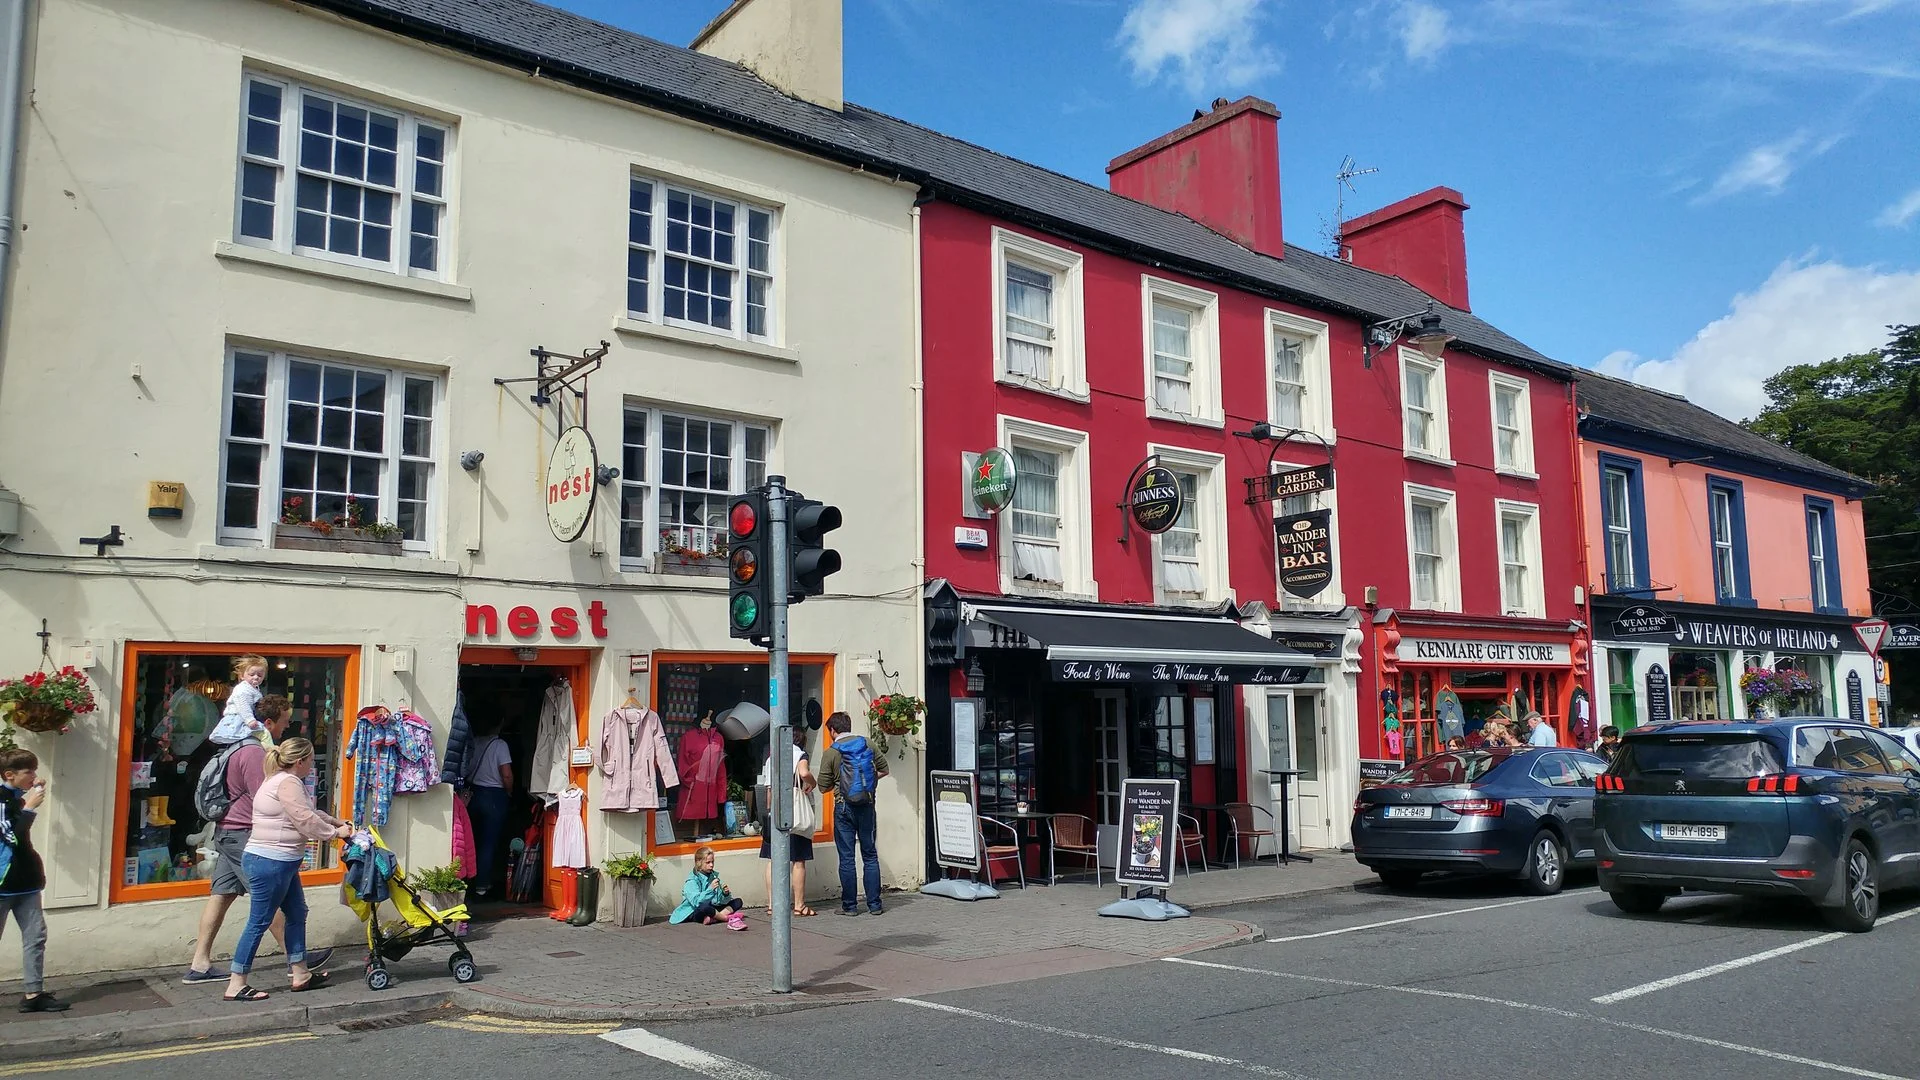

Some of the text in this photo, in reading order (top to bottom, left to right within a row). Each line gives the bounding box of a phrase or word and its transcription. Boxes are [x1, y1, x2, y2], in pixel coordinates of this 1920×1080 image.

[1284, 470, 1317, 485] BEER
[157, 484, 178, 494] Yale
[549, 467, 591, 505] nest
[973, 482, 1008, 497] Heineken
[1277, 478, 1325, 496] GARDEN
[1133, 486, 1175, 505] GUINNESS
[1296, 521, 1308, 529] THE
[1279, 528, 1327, 545] WANDER
[1293, 542, 1314, 554] INN
[1282, 551, 1328, 570] BAR
[1285, 572, 1327, 583] ACCOMMODATION
[466, 600, 608, 638] nest
[1620, 617, 1667, 627] WEAVERS
[1689, 622, 1827, 650] WEAVERS OF IRELAND
[1860, 626, 1881, 635] YIELD
[1416, 641, 1554, 661] KENMARE GIFT STORE
[1062, 661, 1131, 681] Food & Wine
[1152, 664, 1230, 682] The Wander Inn
[1251, 666, 1300, 683] Live Music
[1362, 767, 1387, 775] WANDER
[1138, 788, 1156, 796] Welcome
[1393, 808, 1425, 817] 171-C-8419
[1667, 826, 1718, 837] 181-KY-1896
